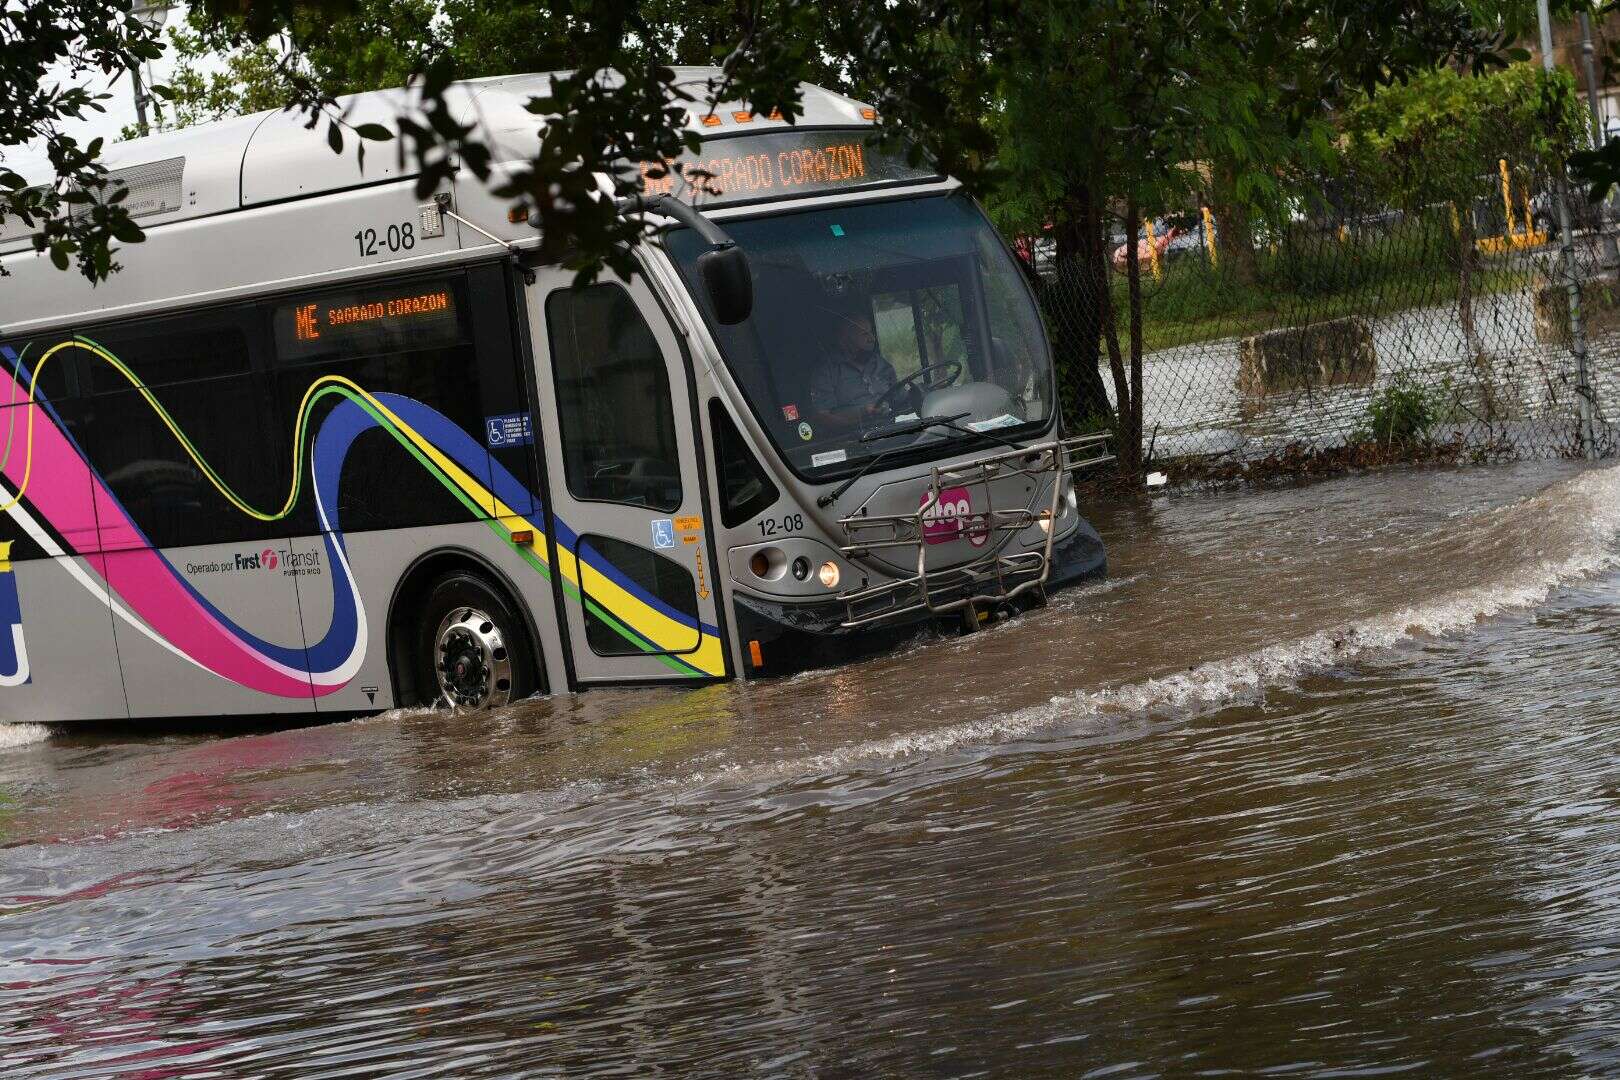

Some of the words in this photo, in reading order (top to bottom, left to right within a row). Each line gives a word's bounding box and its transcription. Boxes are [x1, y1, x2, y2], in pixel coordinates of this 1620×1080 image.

[778, 144, 865, 186] CORAZON
[355, 222, 415, 257] 12-08
[296, 303, 320, 341] ME
[328, 302, 385, 326] SAGRADO
[387, 290, 449, 317] CORAZON
[757, 513, 804, 537] 12-08
[186, 562, 220, 576] Operado
[221, 562, 234, 575] por
[234, 552, 261, 571] First
[278, 548, 321, 568] Transit
[283, 568, 306, 577] PUERTO
[306, 567, 321, 576] RICO
